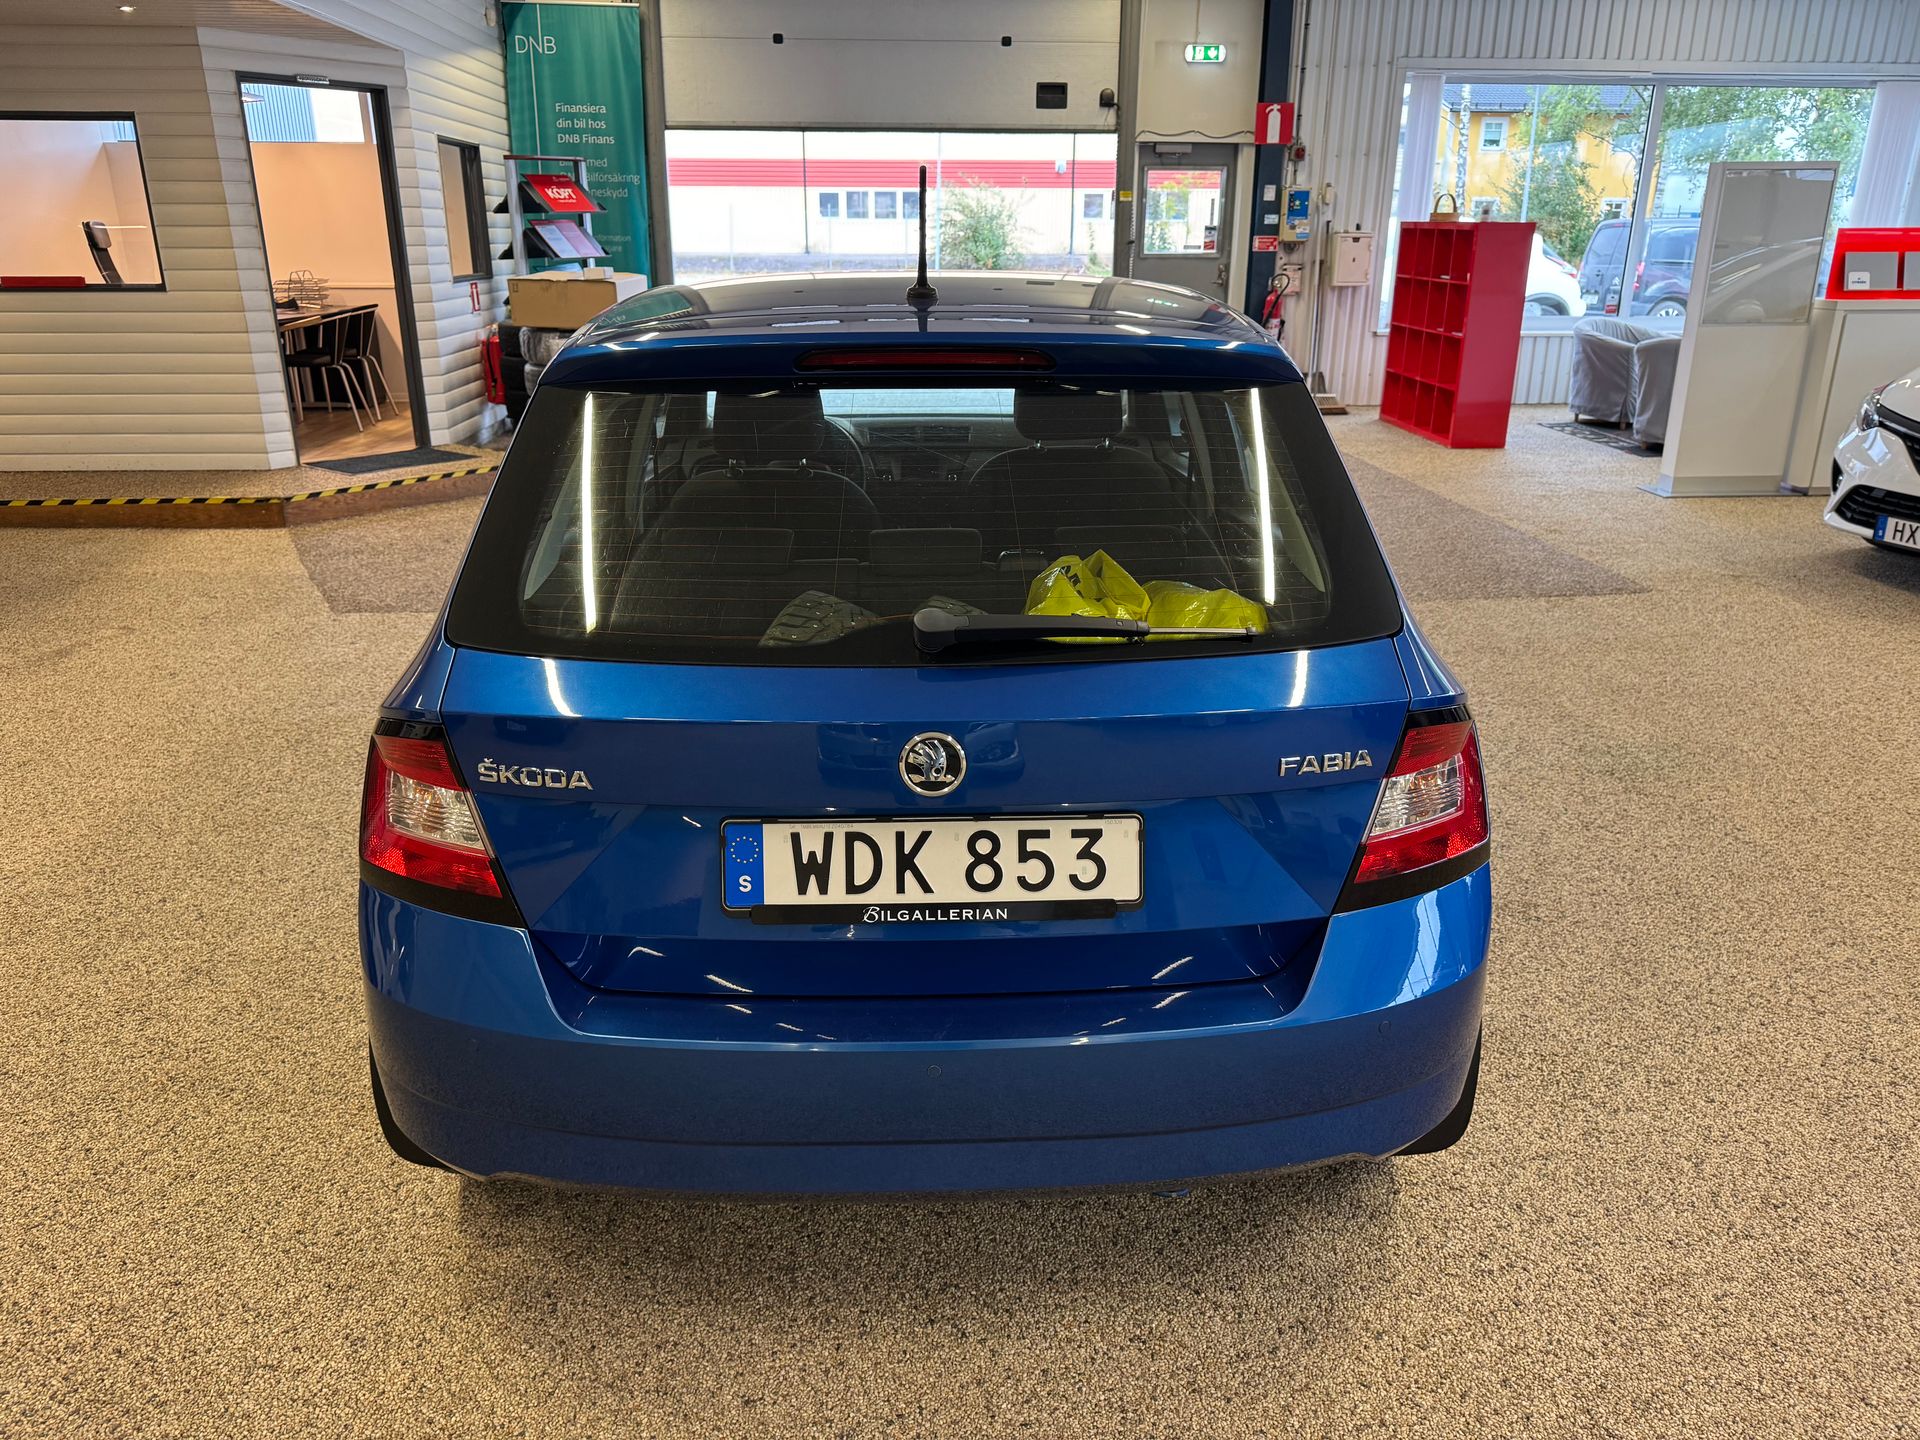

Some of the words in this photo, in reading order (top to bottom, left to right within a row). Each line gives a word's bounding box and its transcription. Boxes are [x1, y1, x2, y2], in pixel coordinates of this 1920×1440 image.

[514, 35, 557, 54] DNB
[555, 102, 607, 114] Finansiera
[556, 117, 572, 128] din
[574, 118, 586, 129] bil
[588, 118, 607, 129] hos
[557, 133, 580, 144] DNB
[582, 134, 615, 145] Finans
[586, 157, 608, 168] med
[544, 185, 577, 199] KÖPT
[1279, 749, 1373, 777] FABIA
[477, 757, 594, 791] ŠKODA
[790, 829, 935, 896] WDK
[964, 828, 1108, 893] 853
[738, 875, 752, 893] S
